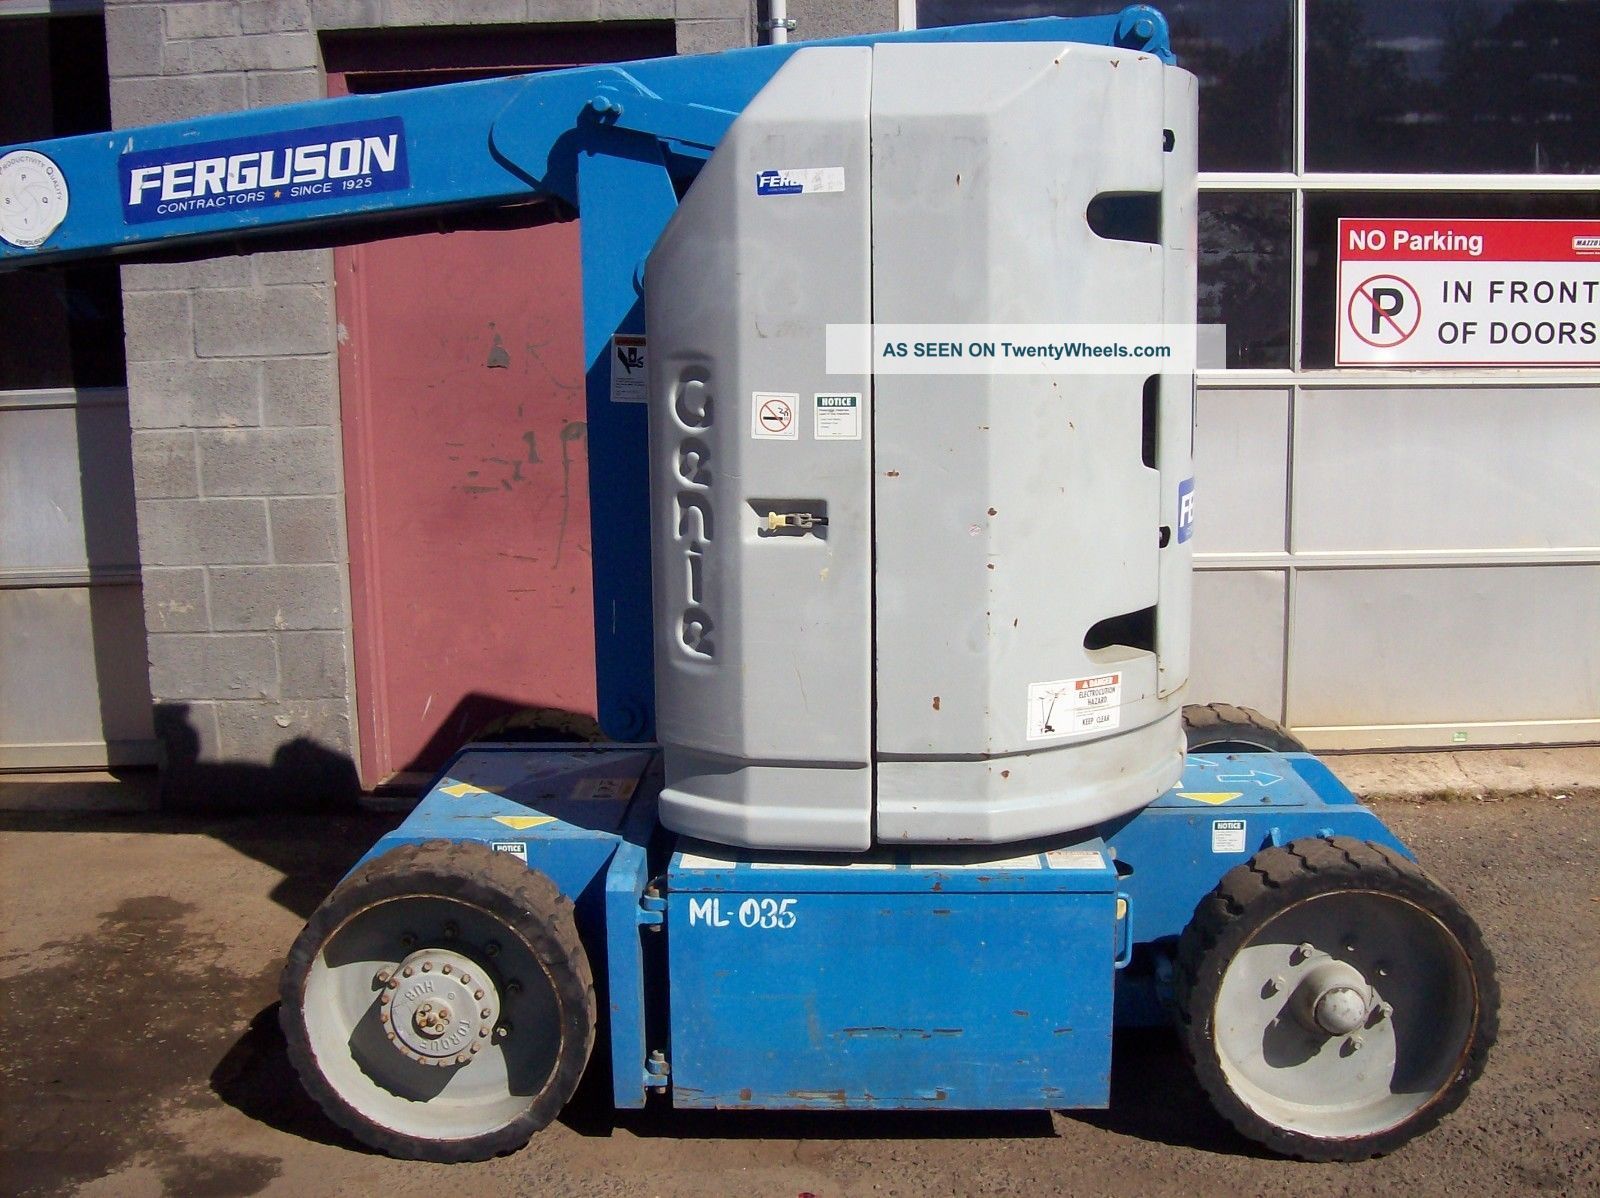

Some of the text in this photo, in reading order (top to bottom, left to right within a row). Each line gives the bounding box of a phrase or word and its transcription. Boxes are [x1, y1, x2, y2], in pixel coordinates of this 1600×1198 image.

[128, 134, 398, 206] FERGUSON
[156, 177, 373, 215] CONTRACTORS SINCE 1925
[1349, 230, 1484, 256] NO Parking
[1442, 280, 1599, 304] IN FRONT
[1438, 321, 1597, 345] OF DOORS
[821, 397, 852, 406] NOTICE
[1087, 696, 1107, 705] HAZARD
[689, 897, 798, 929] ML-035
